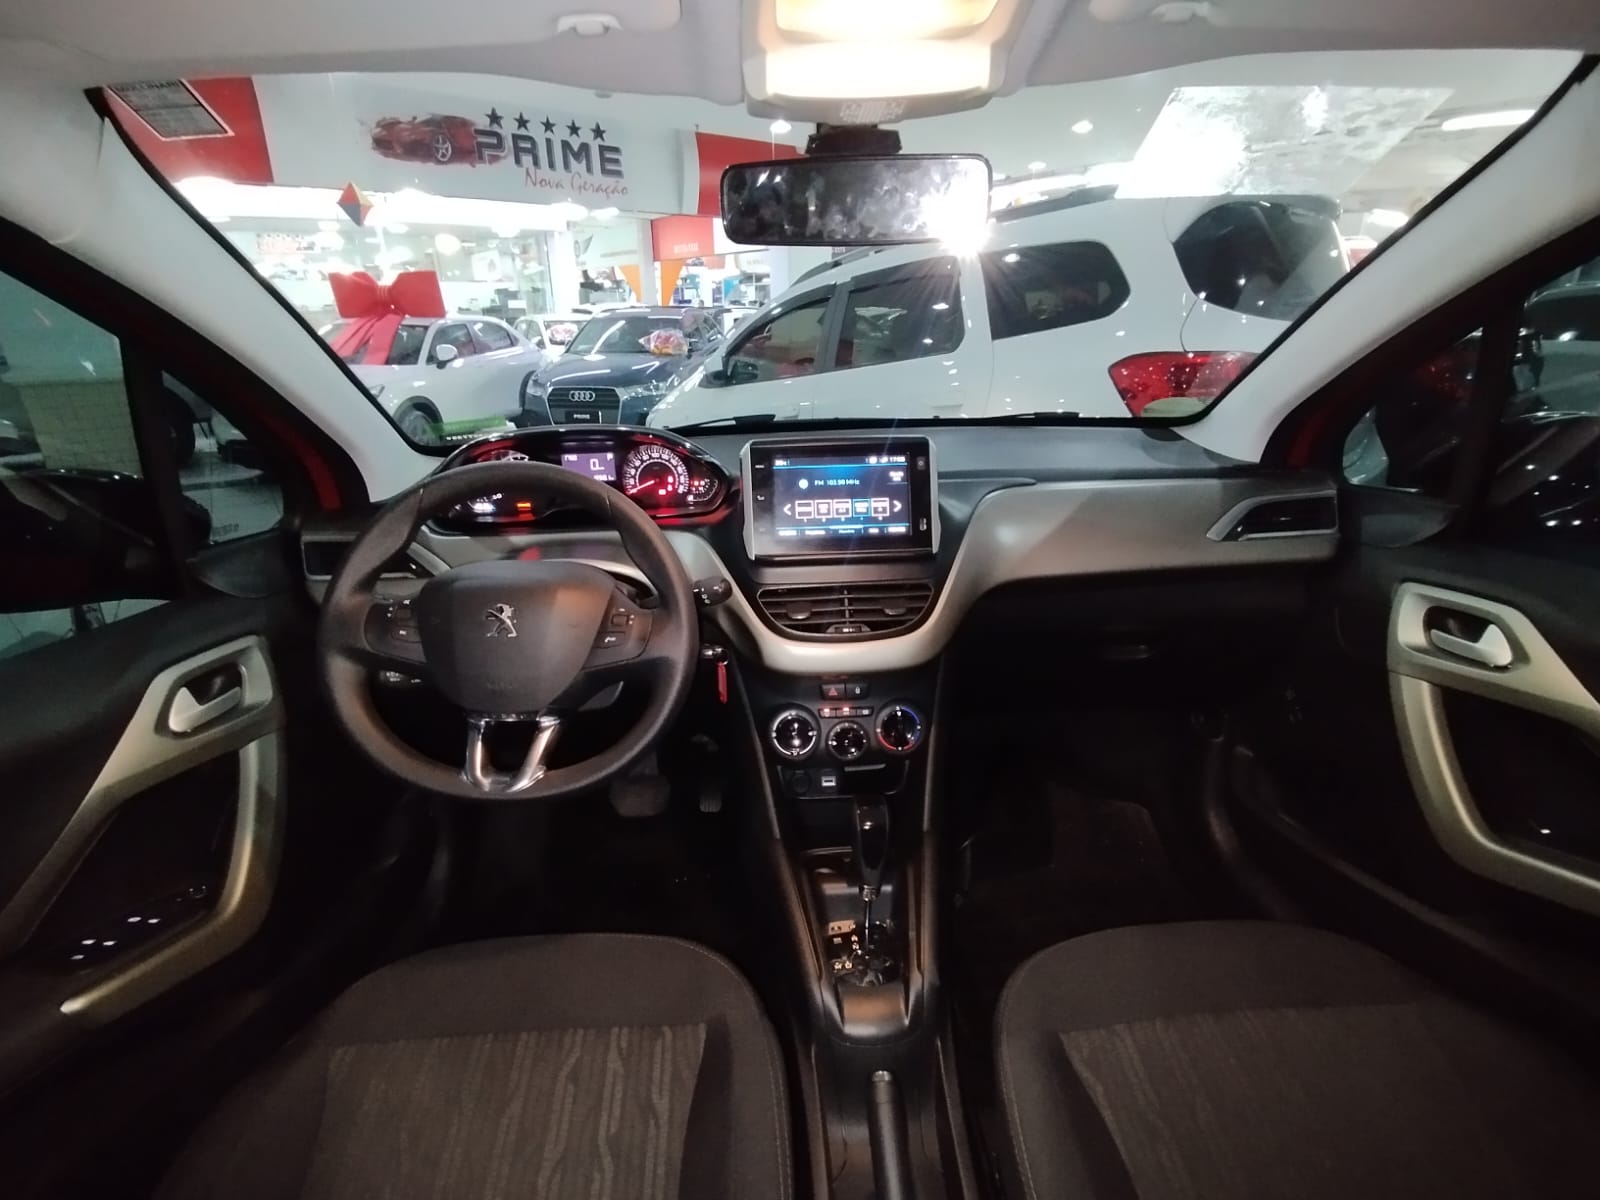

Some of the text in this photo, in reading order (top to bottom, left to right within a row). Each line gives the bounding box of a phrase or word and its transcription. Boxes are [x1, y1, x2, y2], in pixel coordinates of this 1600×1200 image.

[474, 128, 624, 179] PRIME
[525, 168, 629, 199] Nova Geração
